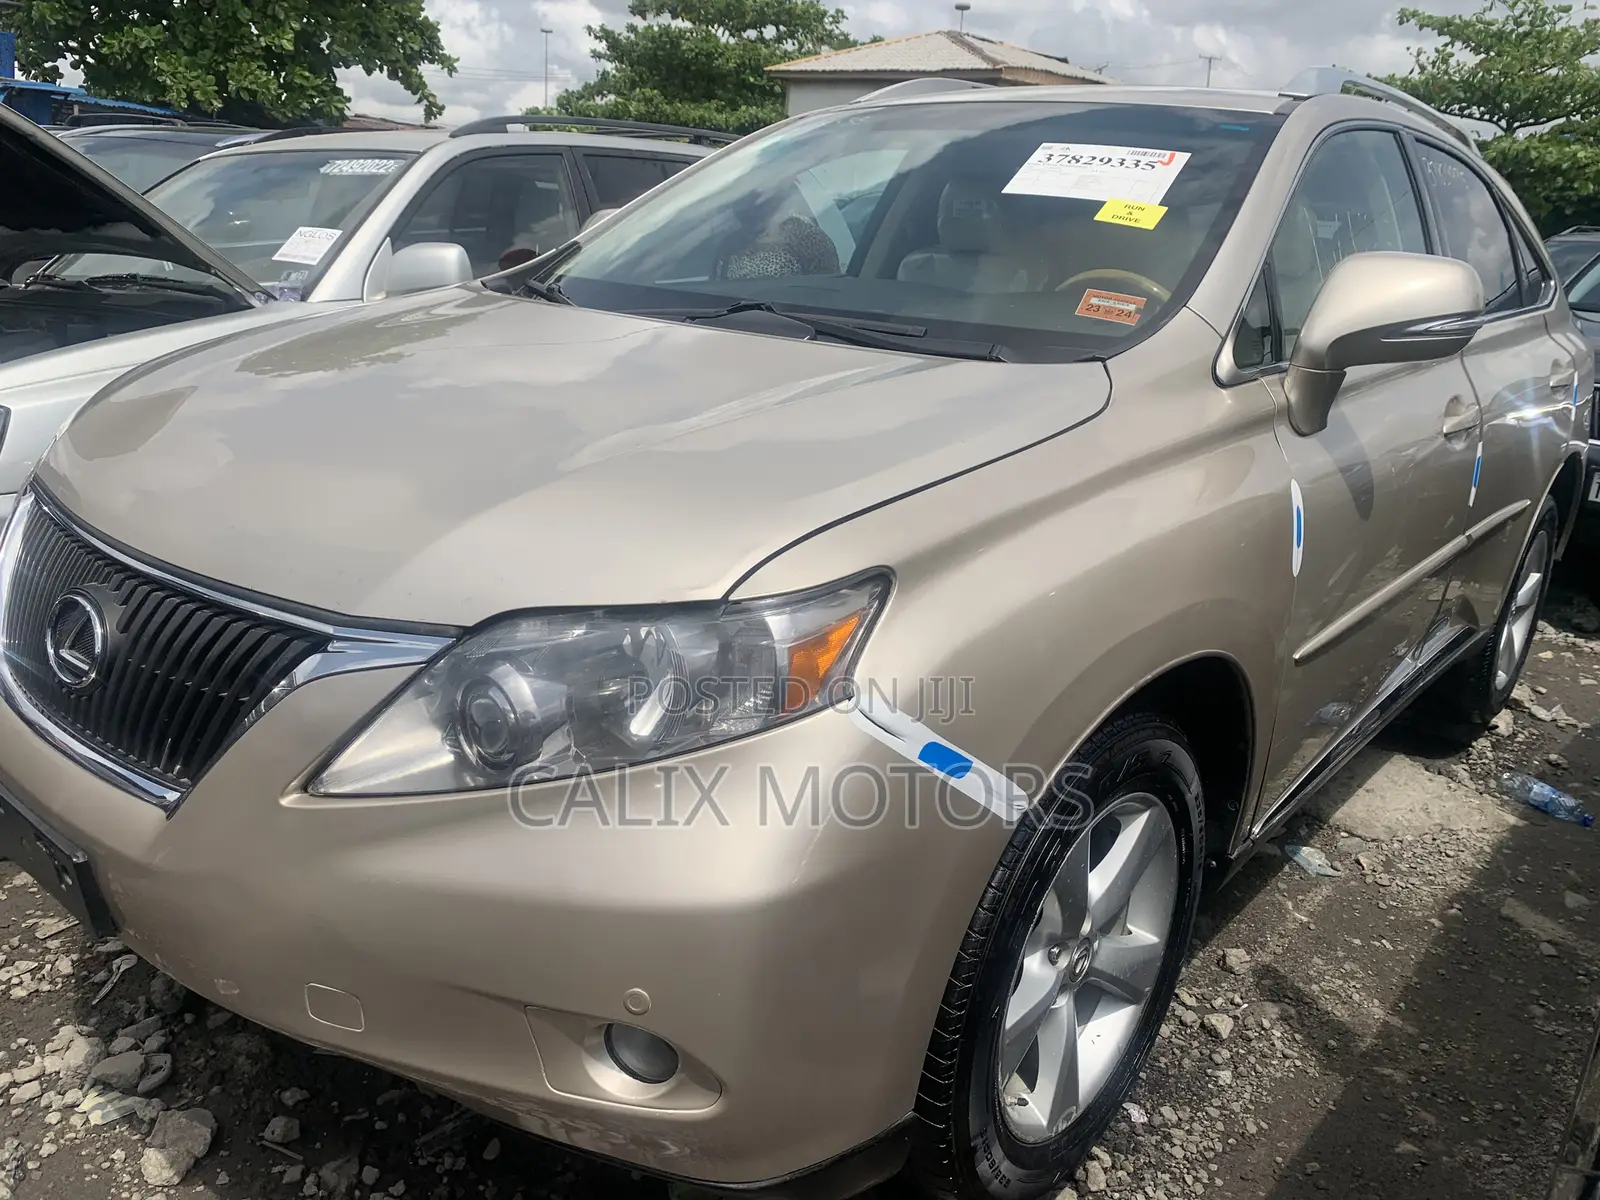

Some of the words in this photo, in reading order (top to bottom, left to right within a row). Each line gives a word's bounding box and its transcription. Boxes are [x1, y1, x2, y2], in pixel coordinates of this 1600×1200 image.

[1037, 153, 1158, 171] 37829335
[1123, 204, 1146, 212] RUN
[1111, 214, 1141, 223] DRIVE
[1085, 303, 1102, 313] 23
[1115, 309, 1133, 319] 24
